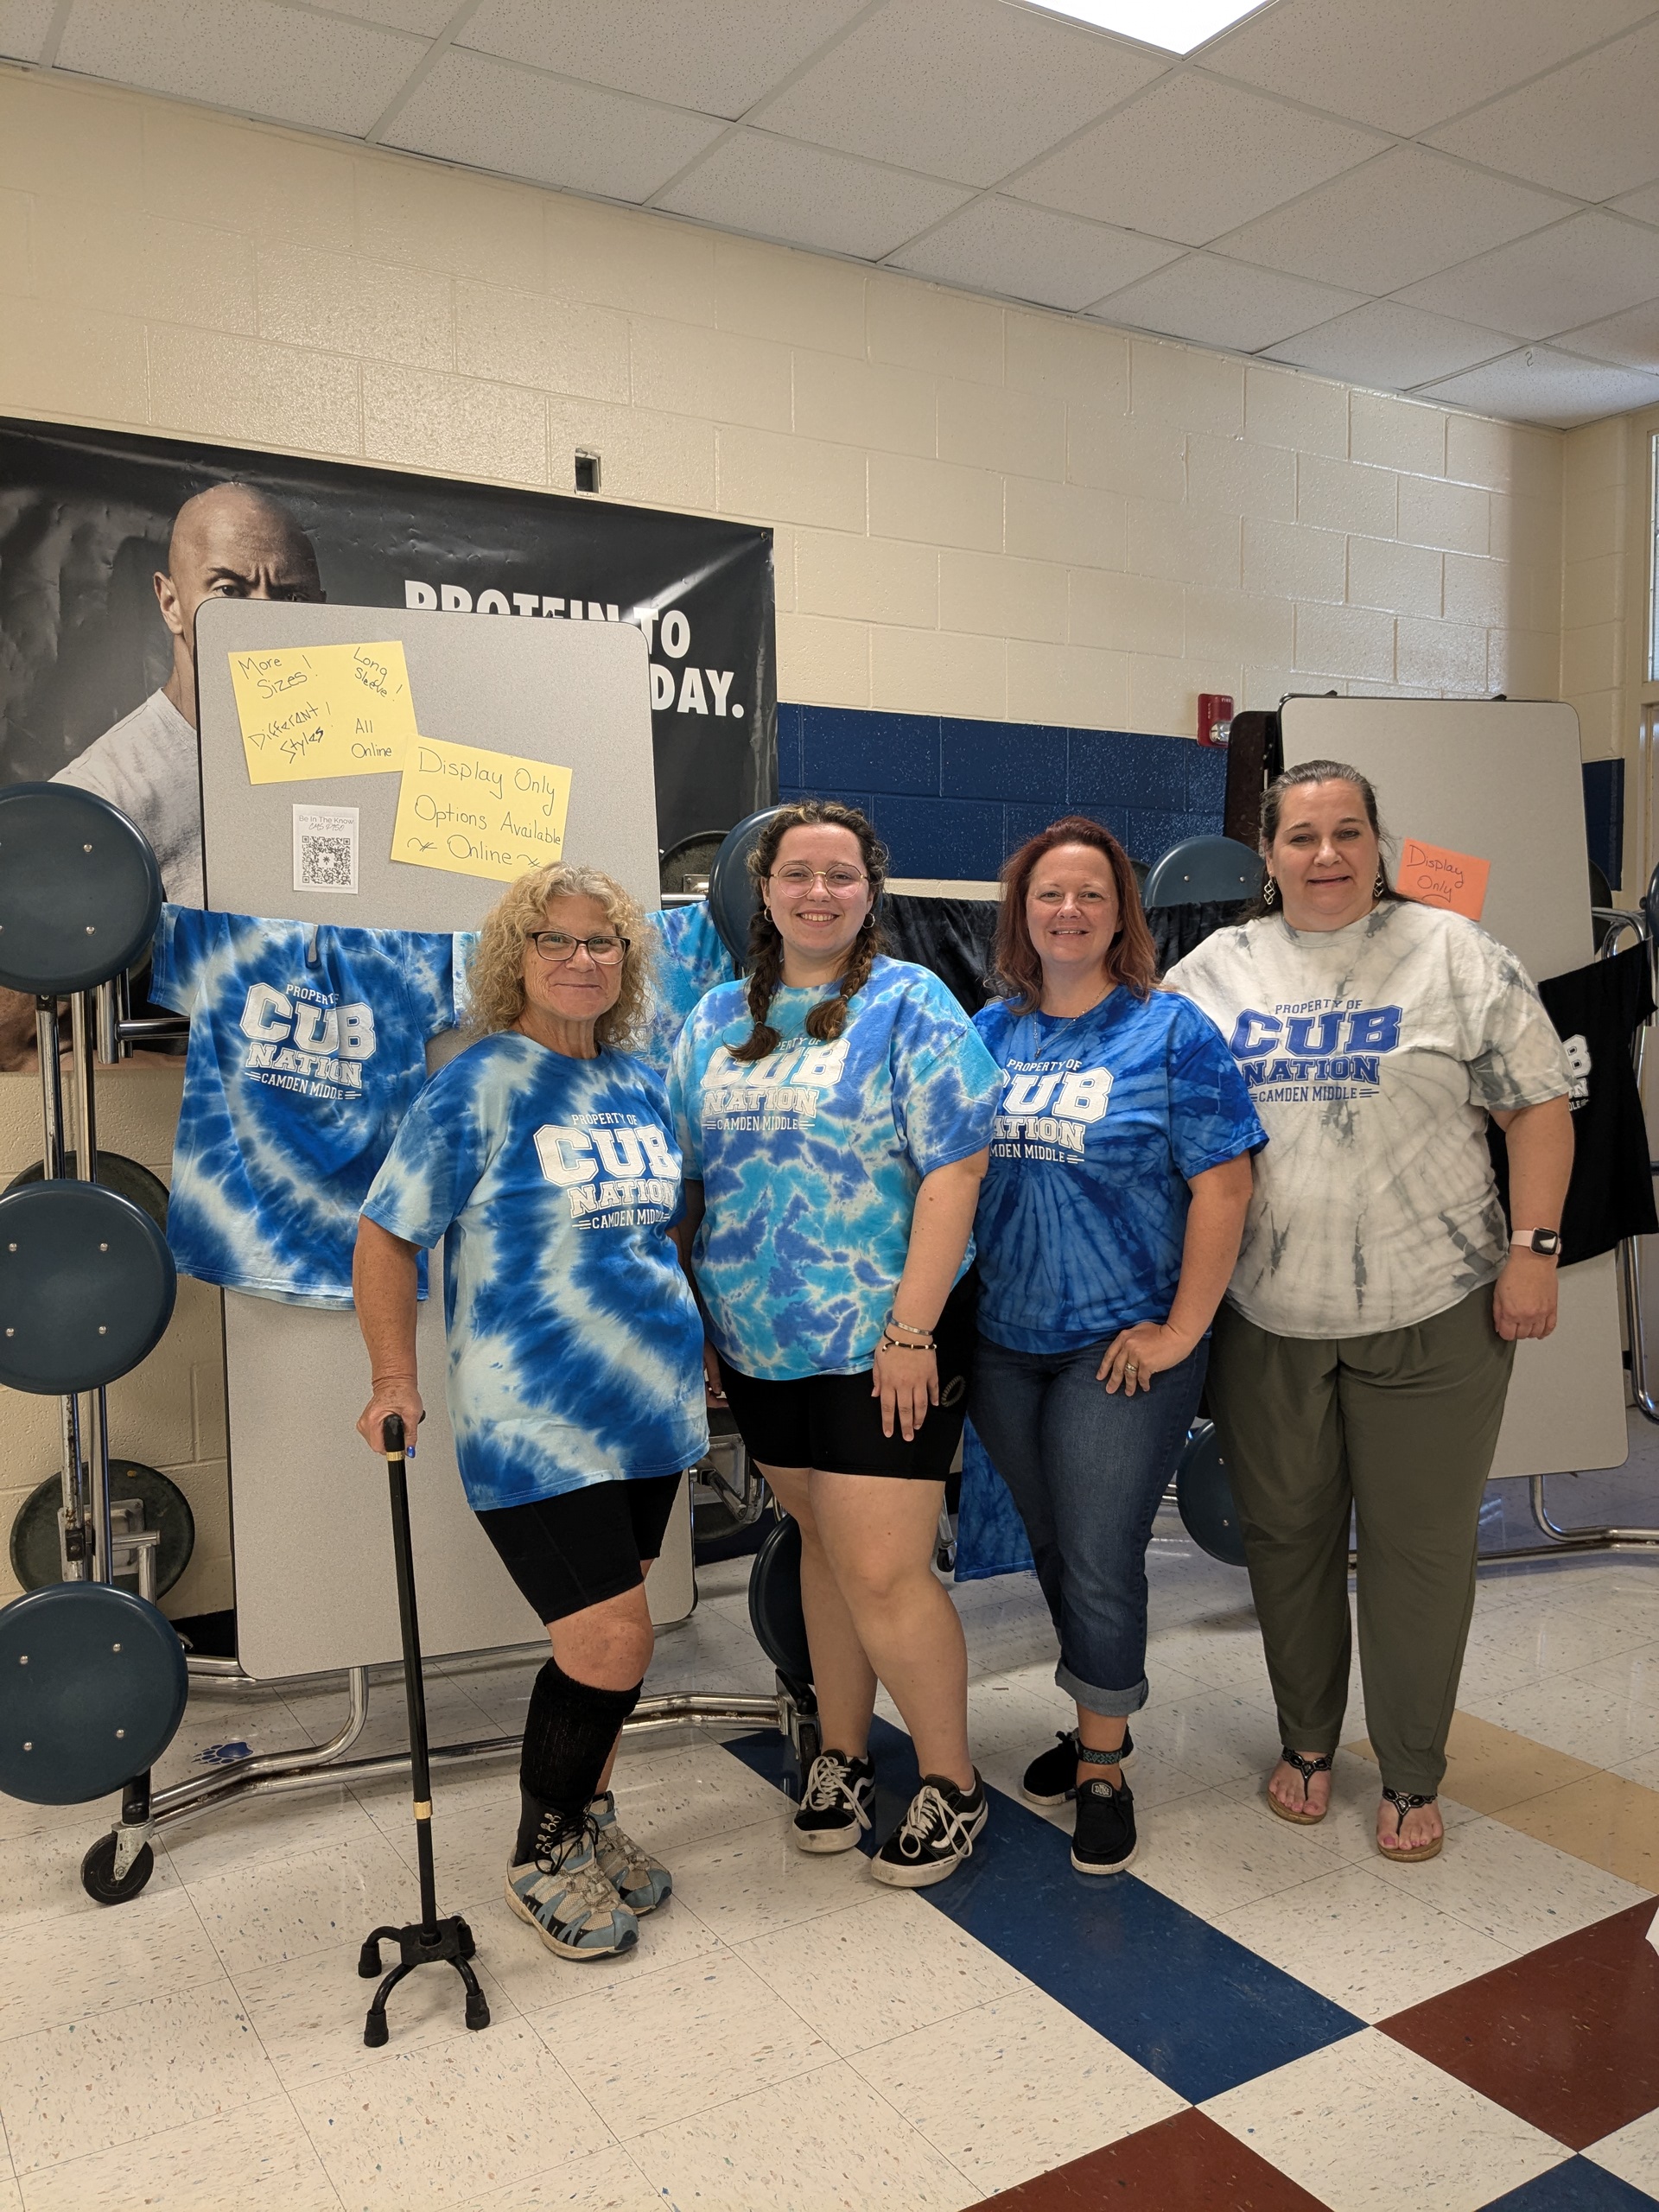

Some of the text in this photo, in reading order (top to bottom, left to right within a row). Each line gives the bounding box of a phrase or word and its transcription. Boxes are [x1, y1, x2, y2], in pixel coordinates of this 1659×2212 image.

[633, 607, 690, 658] TO
[238, 658, 282, 679] More
[353, 647, 387, 685] Long
[356, 718, 373, 734] All
[352, 742, 392, 759] Online
[418, 747, 554, 816] Display Only
[415, 795, 561, 845] Options Available
[447, 834, 512, 865] Online
[1407, 844, 1464, 888] Display
[1417, 875, 1452, 903] Only
[286, 984, 334, 1006] PROPERT
[1275, 999, 1363, 1014] PROPERTY OF
[239, 982, 377, 1060] CUB
[1230, 1004, 1402, 1061] CUB
[245, 1041, 362, 1089] NATION
[700, 1038, 850, 1089] CUB
[1007, 1058, 1082, 1071] PROPERTY OF
[1242, 1054, 1380, 1089] NATION
[261, 1073, 343, 1100] CAMDEN MIDDE
[1002, 1066, 1114, 1123] UB
[1259, 1085, 1357, 1103] CAMDEN MIDDLE
[702, 1087, 819, 1118] NATION
[572, 1113, 638, 1126] PROPERTY OF
[717, 1116, 798, 1131] CAMDEN MIDDLE
[993, 1116, 1086, 1154] ATION
[533, 1124, 681, 1186] CUB
[989, 1143, 1065, 1162] MDEN MIDDLE
[567, 1179, 675, 1218] NATION
[592, 1208, 664, 1230] CAMDEN MIDD
